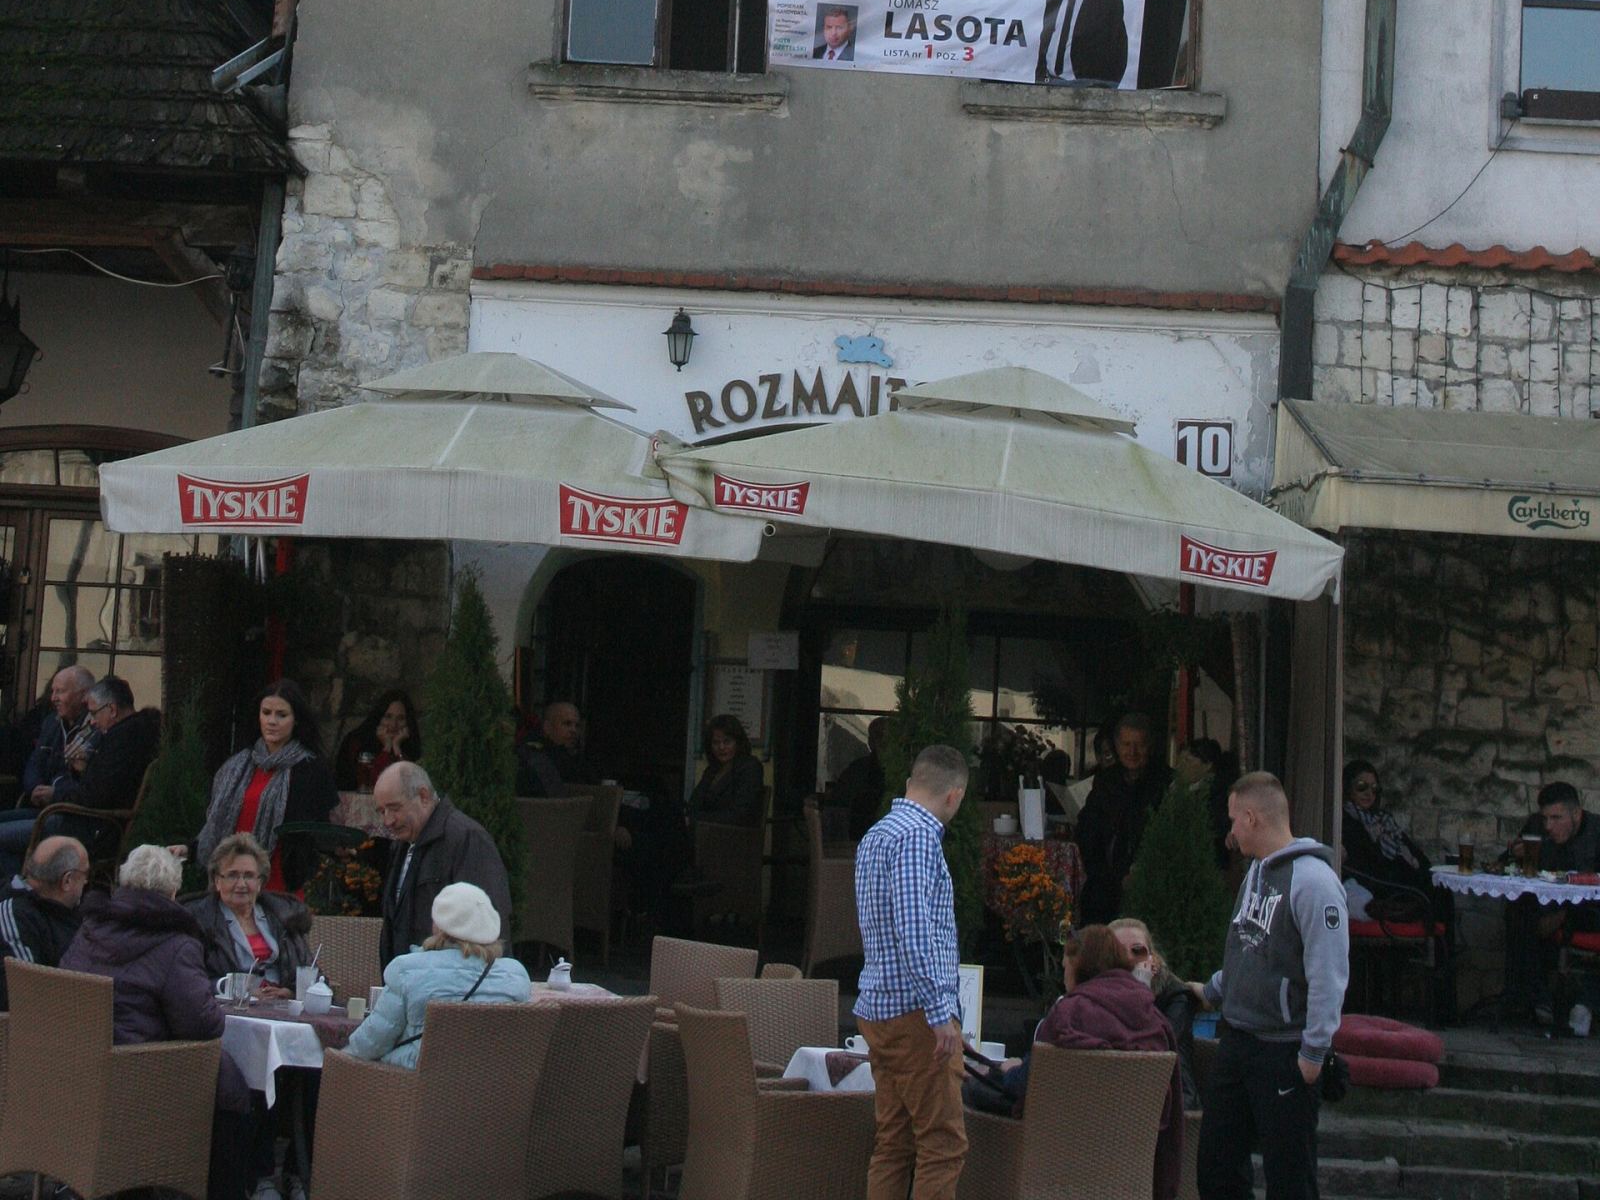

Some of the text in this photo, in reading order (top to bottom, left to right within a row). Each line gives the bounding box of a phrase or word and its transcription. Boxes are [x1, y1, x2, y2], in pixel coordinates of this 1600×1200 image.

[884, 11, 1027, 47] LASOTA
[883, 49, 910, 57] LISTA
[924, 44, 933, 59] 1
[962, 46, 974, 62] 3
[1178, 426, 1231, 473] 10
[187, 484, 300, 520] TYSKIE
[720, 482, 801, 510] TYSKIE
[1508, 496, 1590, 527] Carlsberg
[567, 495, 679, 539] TYSKIE
[1187, 544, 1268, 581] TYSKIE
